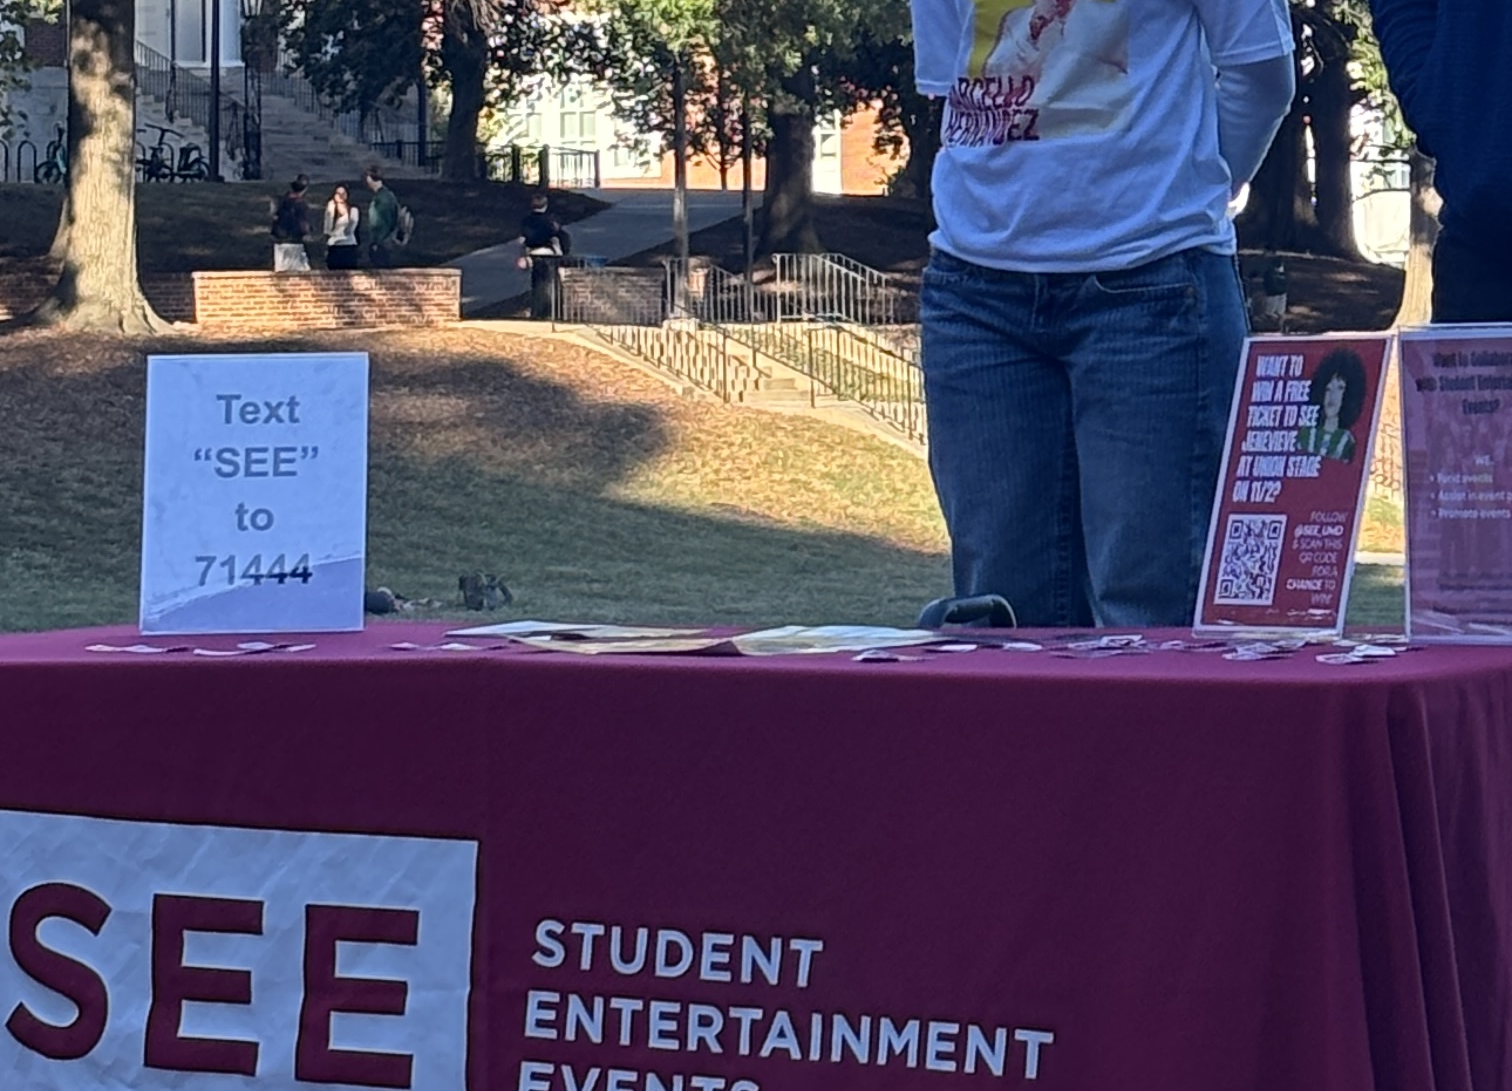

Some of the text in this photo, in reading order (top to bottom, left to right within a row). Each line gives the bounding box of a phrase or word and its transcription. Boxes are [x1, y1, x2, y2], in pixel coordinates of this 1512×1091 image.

[949, 75, 1035, 111] ARCELLO
[1256, 355, 1304, 377] WANT TO
[1251, 380, 1312, 402] WIN A FREE
[216, 393, 300, 425] Text
[1247, 405, 1320, 427] TICKET TO SEE
[1241, 430, 1298, 452] JENEVIEVE
[193, 445, 319, 479] “SEE”
[1236, 456, 1322, 477] AT UNION STAGE
[1232, 481, 1250, 502] ON
[235, 502, 275, 532] to
[1310, 511, 1348, 523] FOLLOW
[195, 553, 313, 587] 71444
[531, 918, 824, 988] STUDENT
[6, 881, 420, 1089] SEE
[523, 989, 1055, 1080] ENTERTAINMENT
[518, 1060, 760, 1091] EVE
